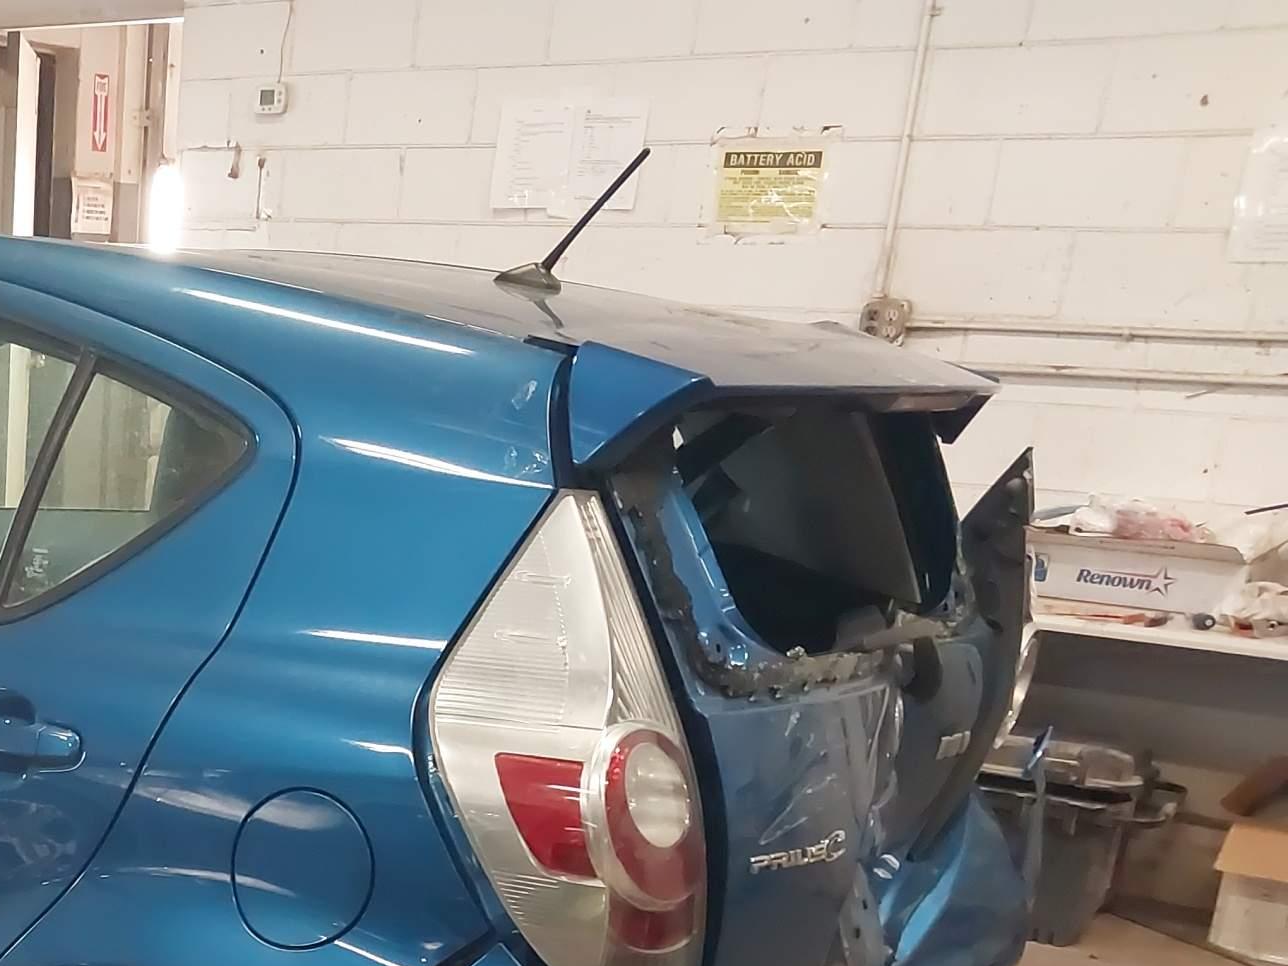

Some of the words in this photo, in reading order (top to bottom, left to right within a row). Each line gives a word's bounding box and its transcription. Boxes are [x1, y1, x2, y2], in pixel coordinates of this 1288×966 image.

[729, 152, 784, 167] BATTERY
[785, 151, 817, 167] ACID
[1076, 568, 1152, 591] Renown
